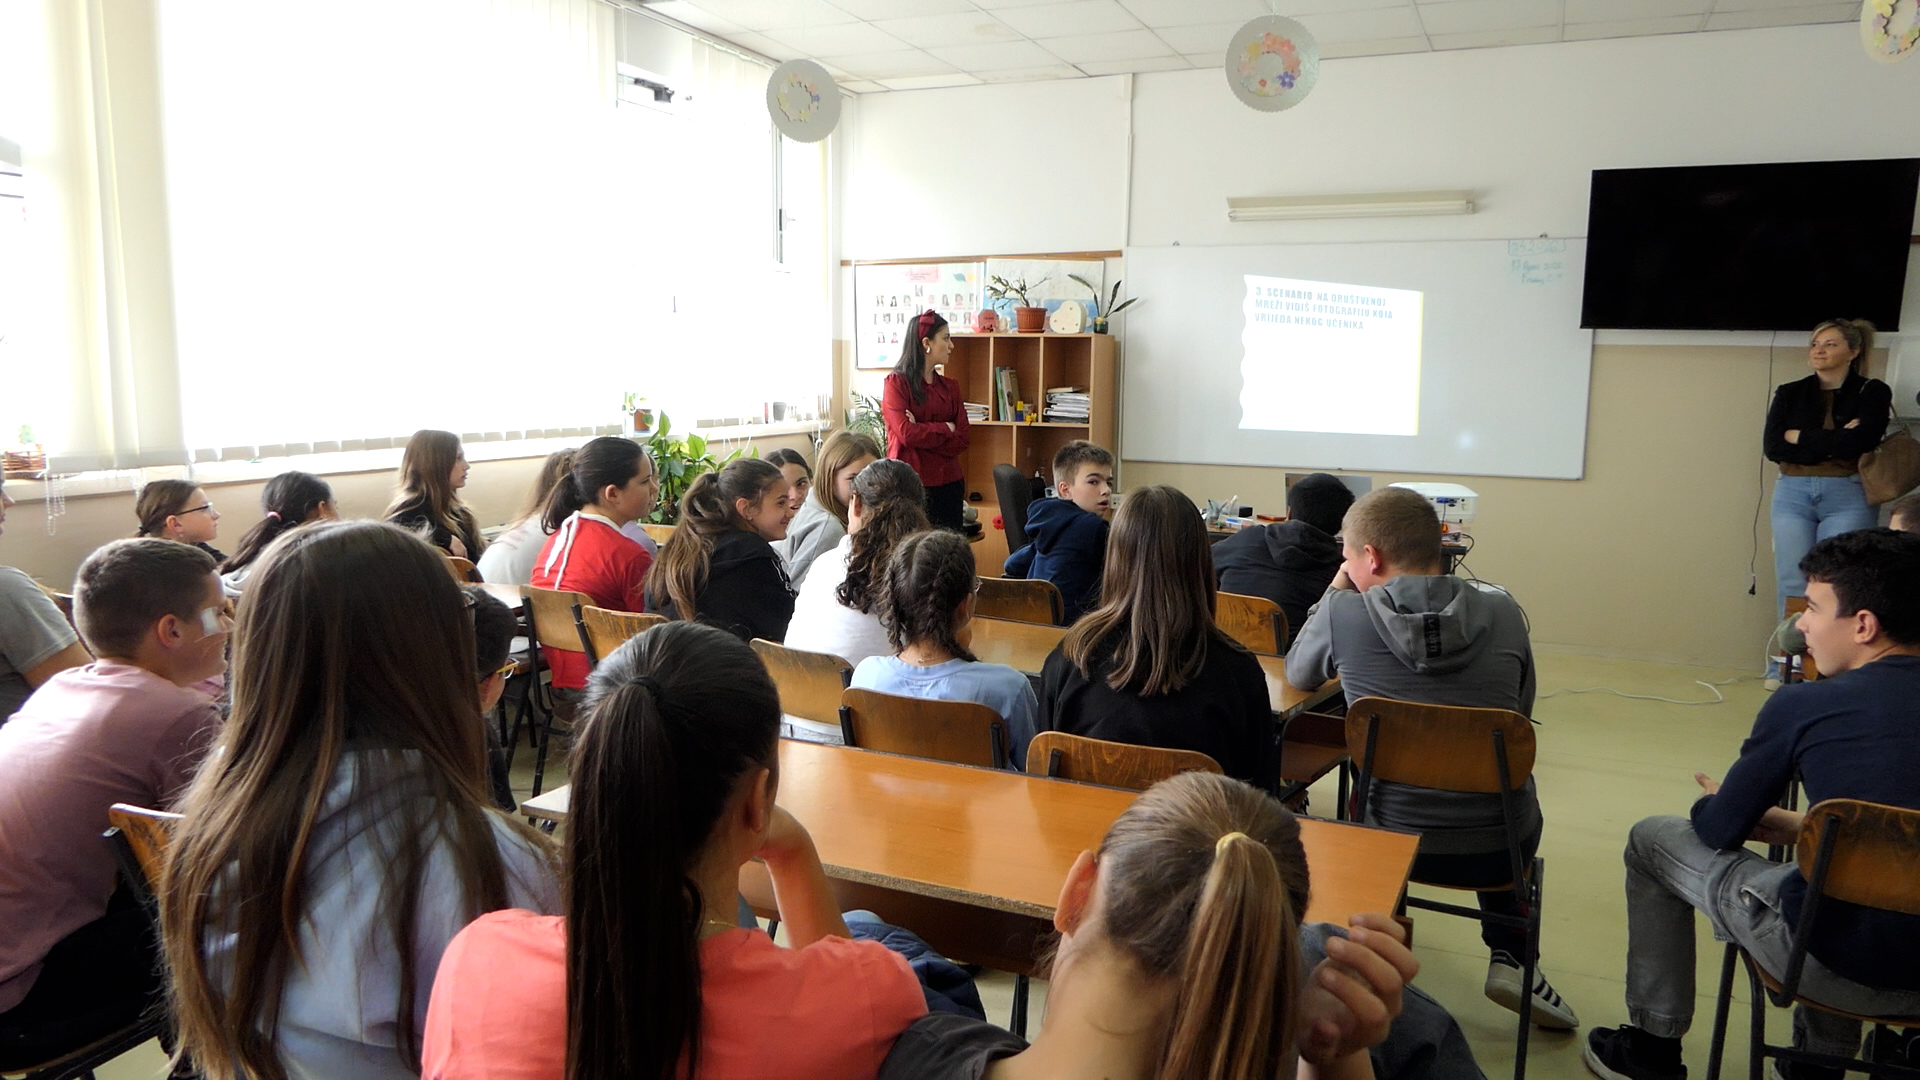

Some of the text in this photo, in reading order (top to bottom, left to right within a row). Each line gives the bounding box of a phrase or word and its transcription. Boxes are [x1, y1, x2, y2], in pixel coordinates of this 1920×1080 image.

[1255, 299, 1283, 310] MREŽI
[1285, 301, 1310, 312] VIDIŠ
[1312, 304, 1370, 317] FOTOGRAFIJU
[1317, 292, 1329, 302] NA
[1331, 294, 1386, 307] DRUŠTVENOJ
[1255, 312, 1364, 330] VRIJEDA NEKOG UČENIKA
